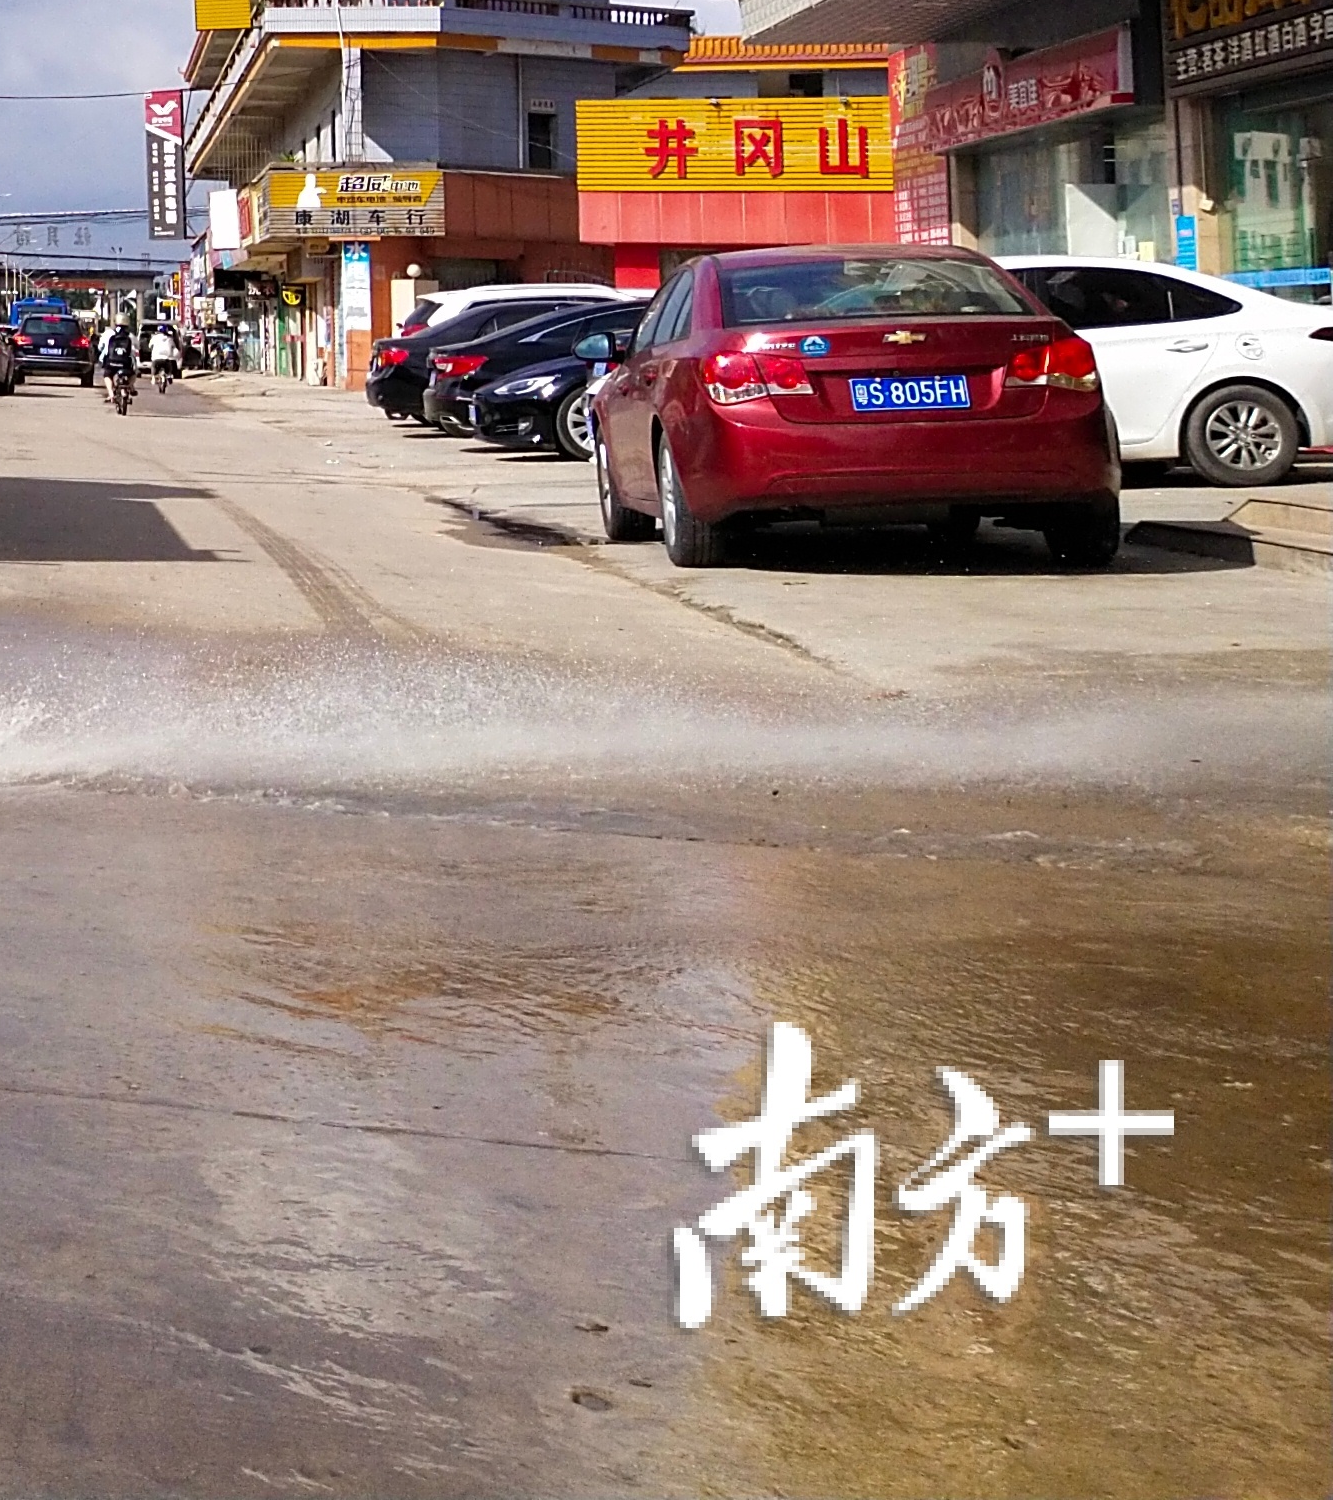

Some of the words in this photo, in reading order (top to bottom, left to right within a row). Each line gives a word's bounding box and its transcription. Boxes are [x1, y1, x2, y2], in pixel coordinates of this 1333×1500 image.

[1007, 78, 1041, 110] 美宜佳
[645, 118, 870, 180] 井冈山
[294, 209, 427, 226] 康湖车行
